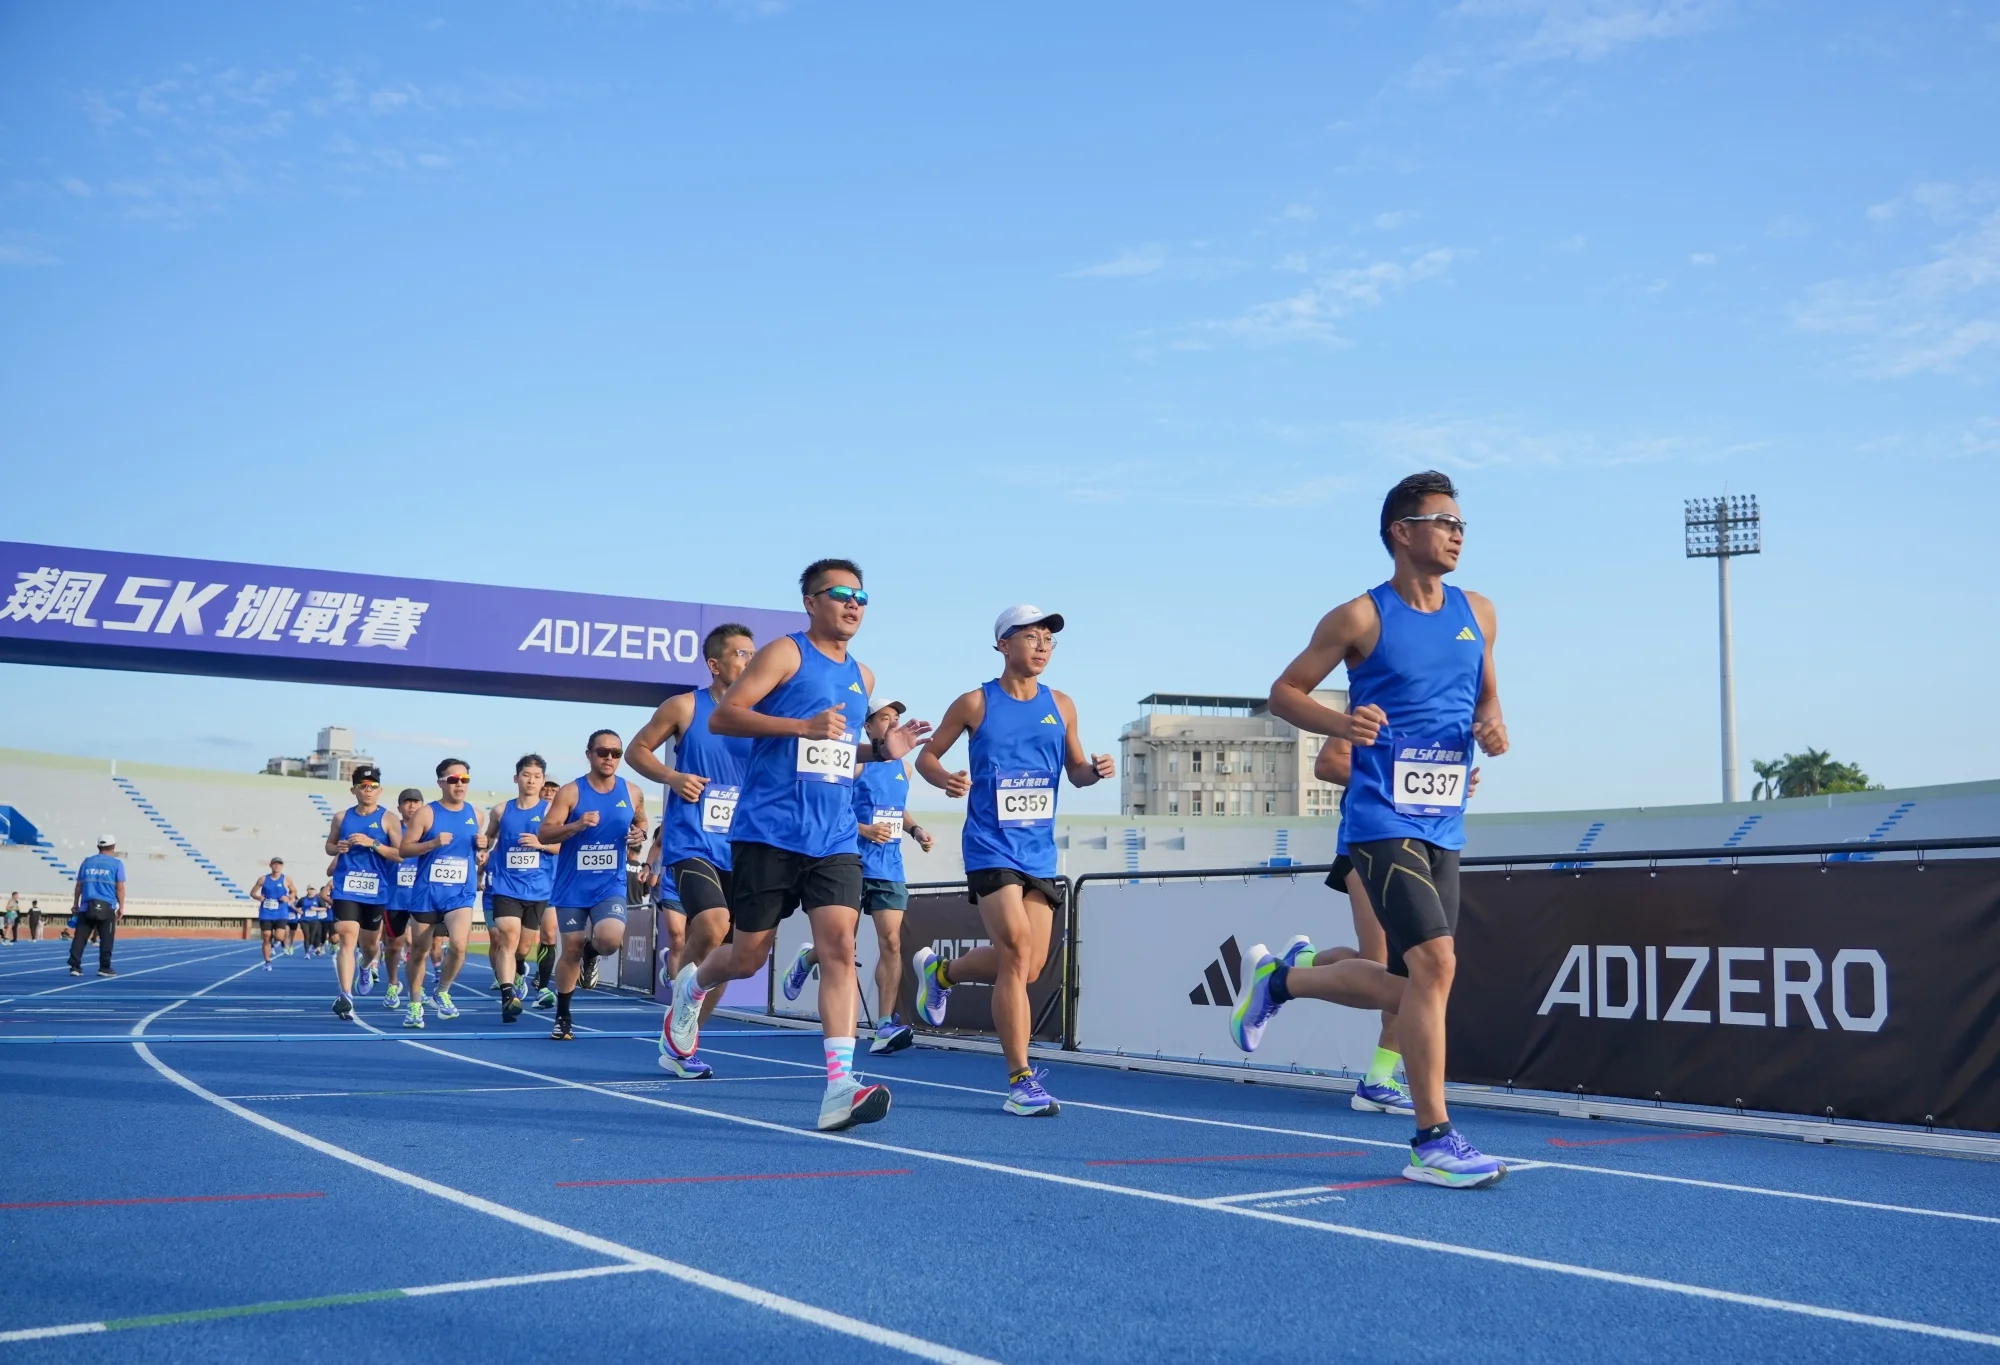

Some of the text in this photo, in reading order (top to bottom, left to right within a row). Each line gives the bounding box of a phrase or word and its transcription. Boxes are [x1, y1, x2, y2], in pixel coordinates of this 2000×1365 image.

[518, 617, 699, 663] ADIZERO
[806, 746, 851, 770] C332
[1404, 771, 1459, 796] C337
[1005, 794, 1048, 813] C359
[710, 804, 734, 820] C3
[510, 855, 536, 865] C357
[582, 854, 613, 866] C350
[85, 868, 110, 876] STAFF
[401, 874, 417, 883] C3
[435, 868, 462, 880] C321
[348, 879, 375, 890] C338
[1536, 944, 1888, 1032] ADIZERO
